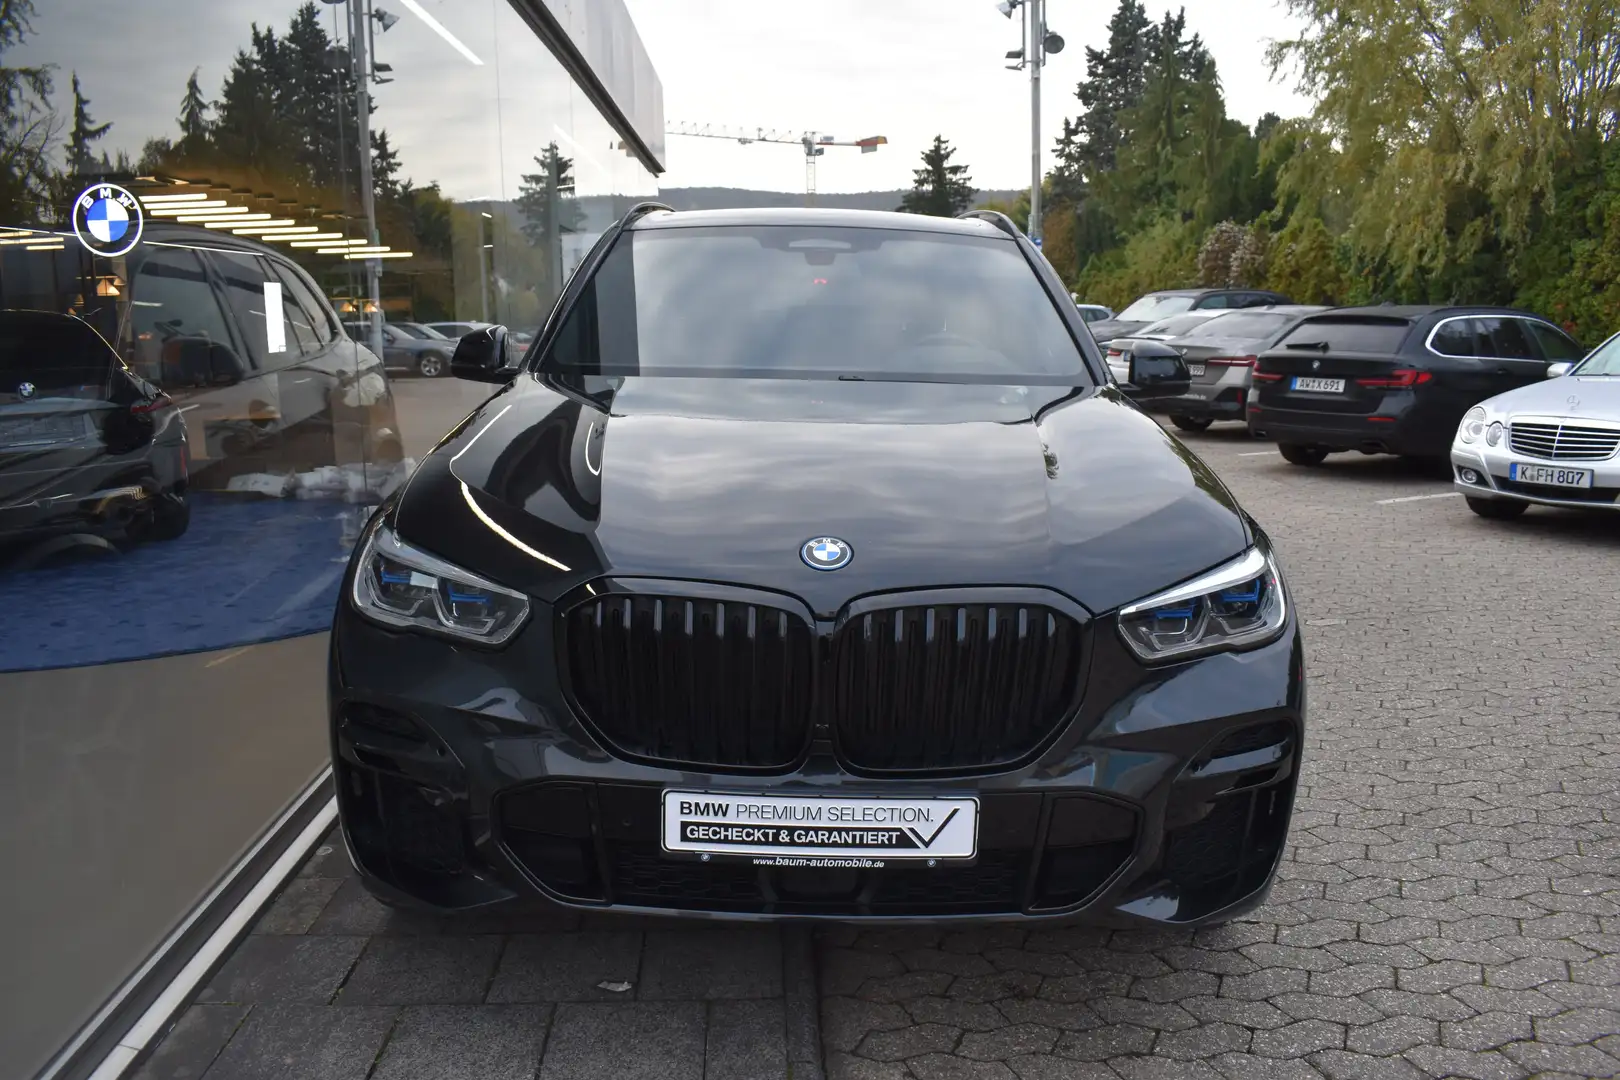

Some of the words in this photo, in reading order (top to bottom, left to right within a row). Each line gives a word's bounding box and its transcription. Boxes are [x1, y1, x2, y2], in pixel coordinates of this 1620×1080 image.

[1520, 467, 1529, 480] K
[1536, 468, 1554, 483] FH
[1557, 469, 1585, 485] 807
[680, 801, 730, 817] BMW
[736, 804, 822, 821] PREMIUM
[827, 806, 934, 822] SELECTION.
[686, 825, 777, 842] GECHECKT
[778, 829, 791, 843] &
[793, 830, 901, 845] GARANTIERT
[752, 856, 885, 868] www.baum-automobile.de
